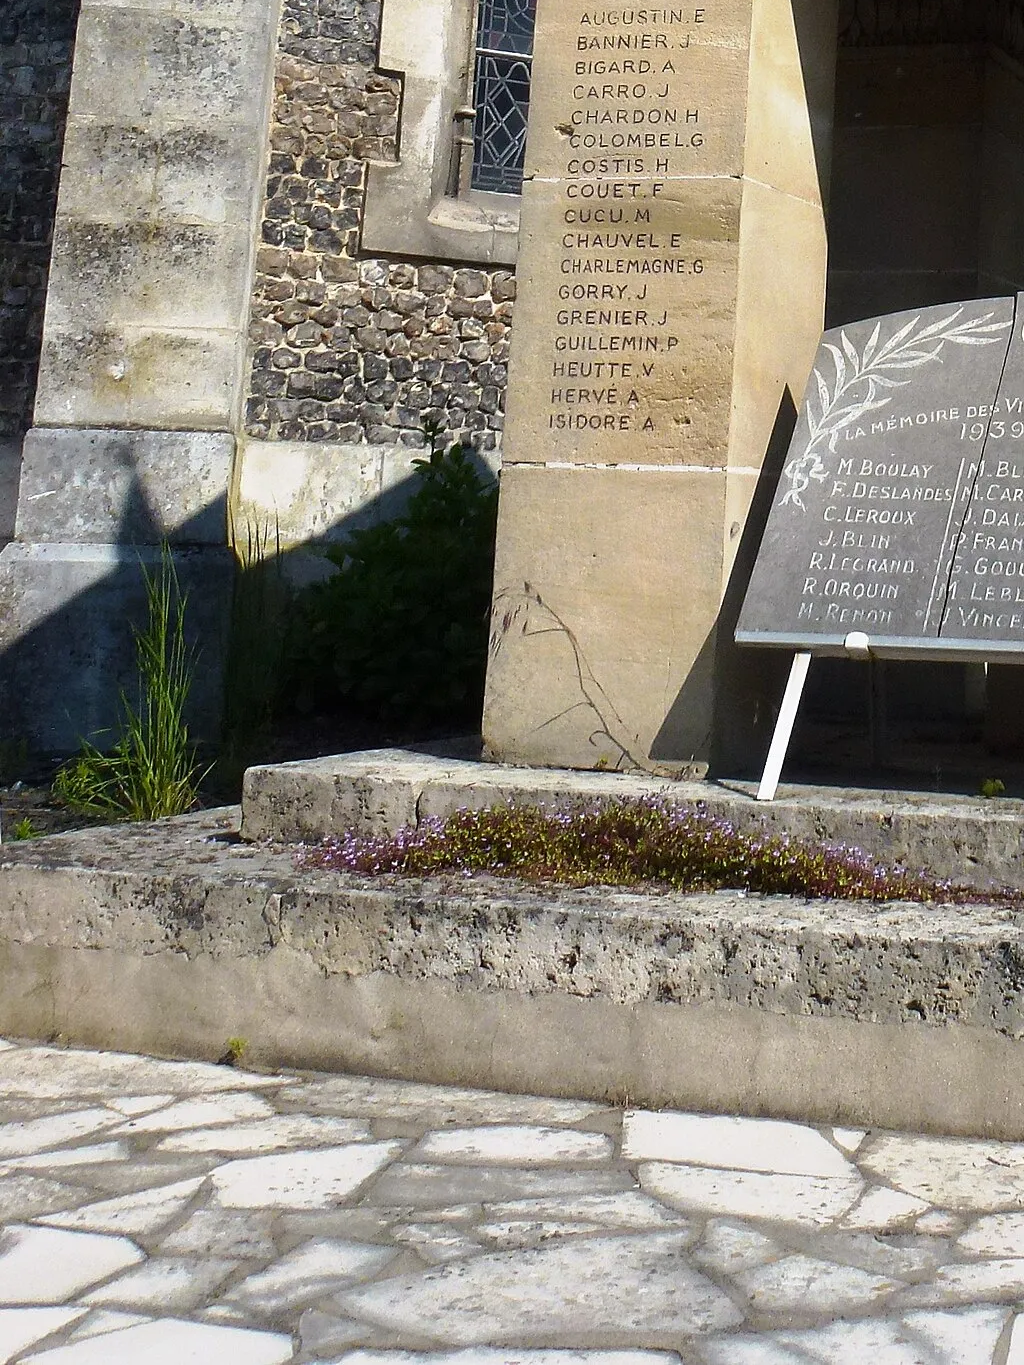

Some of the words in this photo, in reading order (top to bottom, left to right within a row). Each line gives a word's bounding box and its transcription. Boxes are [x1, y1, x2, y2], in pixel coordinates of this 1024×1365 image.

[845, 427, 866, 441] LA
[871, 407, 961, 434] MÉMOIRE
[966, 402, 1000, 419] DES
